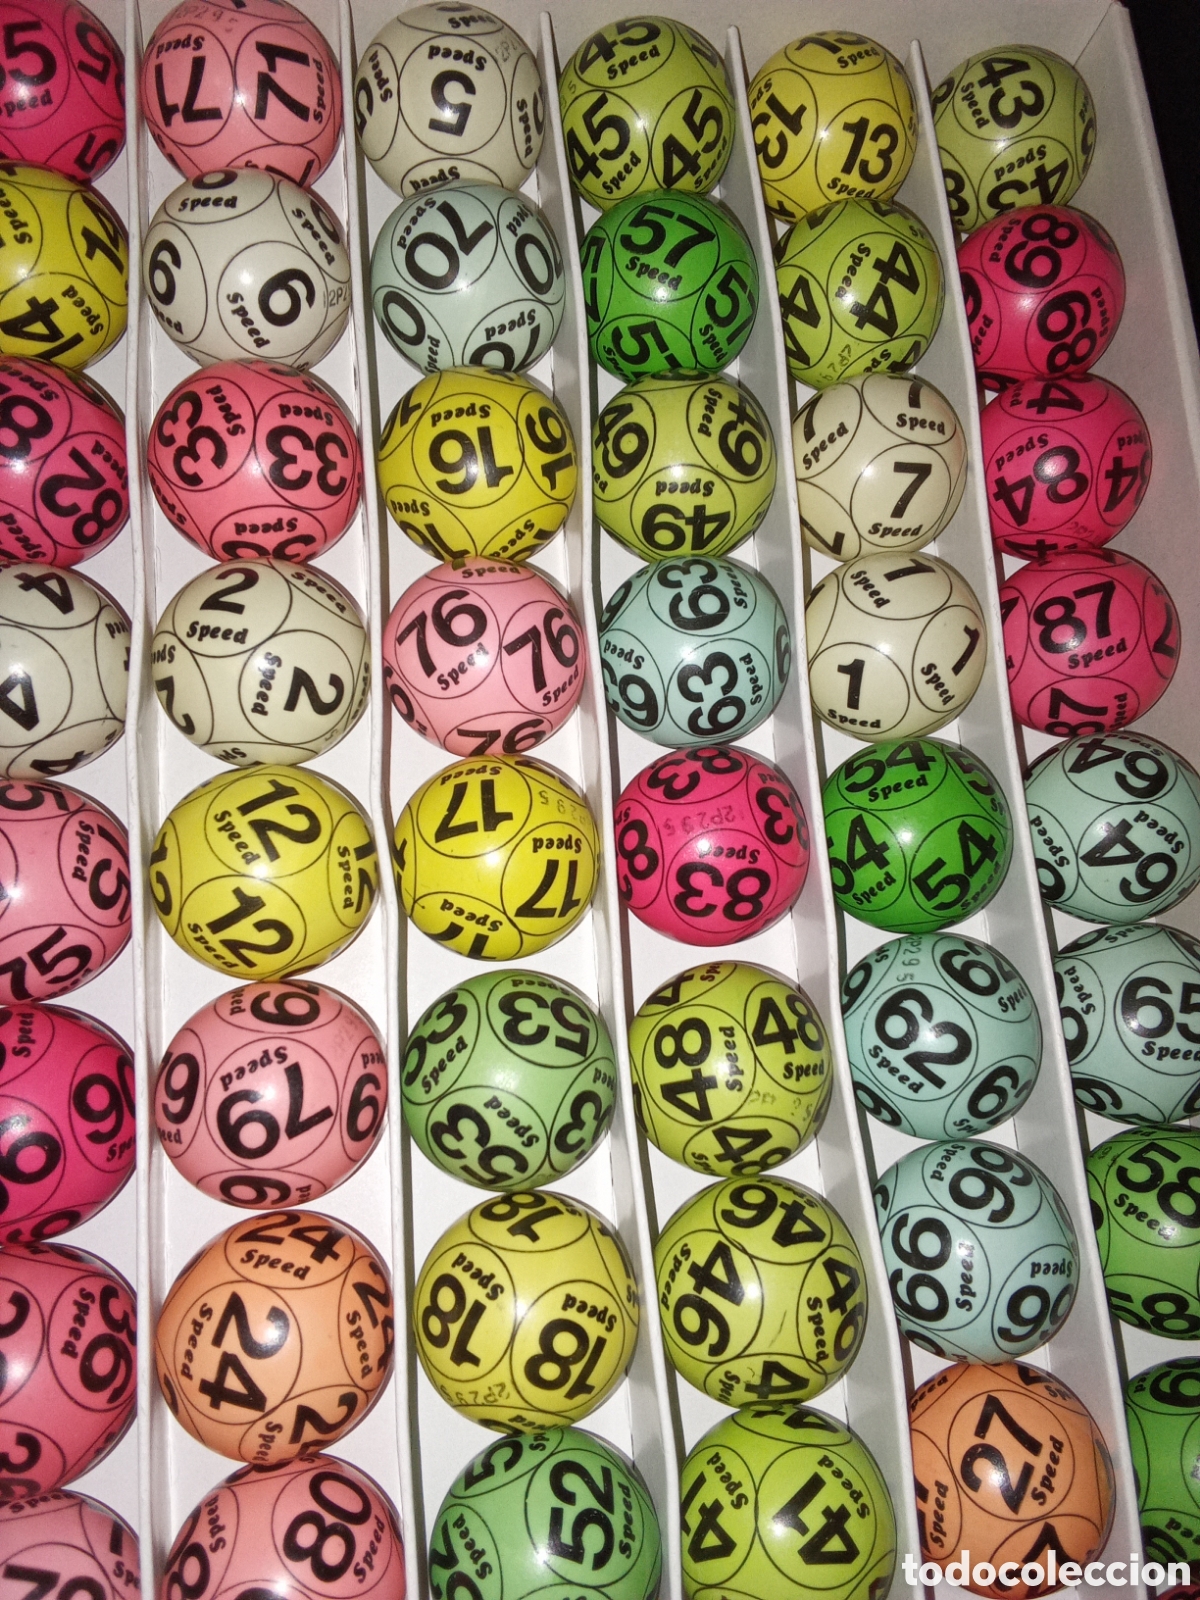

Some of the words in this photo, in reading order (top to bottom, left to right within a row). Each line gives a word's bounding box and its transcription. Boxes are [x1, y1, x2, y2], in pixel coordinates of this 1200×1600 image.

[156, 36, 205, 59] Speed
[428, 44, 487, 71] Speed
[578, 21, 661, 75] 45
[607, 44, 661, 80] Speed
[836, 47, 880, 69] Speed
[155, 56, 223, 127] 71
[255, 41, 310, 122] 71
[313, 58, 326, 124] Speed
[369, 51, 393, 103] Speed
[428, 69, 476, 137] 5
[978, 57, 1045, 129] 43
[516, 98, 534, 158] Speed
[960, 82, 990, 130] Speed
[566, 92, 631, 183] 45
[662, 88, 724, 189] 45
[694, 135, 729, 189] Speed
[841, 116, 898, 183] 13
[994, 144, 1047, 182] Speed
[602, 150, 642, 195] Speed
[827, 177, 876, 199] Speed
[179, 195, 238, 212] Speed
[396, 197, 437, 250] Speed
[292, 208, 336, 266] Speed
[404, 200, 494, 290] 70
[620, 205, 716, 269] 57
[989, 218, 1021, 263] Speed
[258, 268, 316, 327] 6
[625, 256, 683, 291] Speed
[850, 241, 920, 338] 44
[61, 285, 104, 336] Speed
[227, 292, 271, 348] Speed
[484, 308, 536, 341] Speed
[705, 265, 756, 346] 57
[699, 324, 728, 363] Speed
[206, 385, 245, 437] Speed
[278, 404, 333, 426] Speed
[431, 403, 490, 427] Speed
[698, 388, 722, 437] Speed
[896, 413, 945, 435] Speed
[157, 391, 228, 486] 33
[265, 425, 348, 496] 33
[429, 426, 514, 495] 16
[525, 406, 583, 491] 16
[802, 422, 849, 470] Speed
[995, 433, 1048, 471] Speed
[40, 447, 122, 545] 82
[391, 500, 430, 516] Speed
[655, 478, 714, 497] Speed
[890, 462, 932, 519] 7
[993, 445, 1089, 526] 84
[234, 518, 298, 535] Speed
[489, 519, 535, 557] Speed
[641, 503, 730, 551] 49
[868, 523, 923, 538] Speed
[14, 571, 74, 615] 4
[200, 567, 259, 615] 2
[291, 571, 347, 614] Speed
[462, 566, 520, 578] Speed
[657, 559, 730, 630] 63
[719, 565, 748, 609] Speed
[851, 571, 891, 608] Speed
[884, 559, 936, 582] 1
[187, 621, 248, 644] Speed
[396, 590, 488, 678] 76
[1033, 580, 1116, 654] 87
[437, 642, 489, 690] Speed
[503, 608, 579, 693] 76
[603, 640, 645, 669] Speed
[952, 625, 980, 677] 1
[1068, 638, 1128, 669] Speed
[252, 652, 282, 716] Speed
[284, 667, 345, 715] 2
[542, 664, 579, 706] Speed
[677, 652, 746, 736] 63
[739, 653, 763, 706] Speed
[837, 659, 865, 710] 1
[921, 663, 955, 706] Speed
[827, 709, 881, 729] Speed
[440, 765, 502, 785] Speed
[845, 741, 936, 792] 54
[868, 774, 929, 802] Speed
[1068, 738, 1169, 799] 64
[214, 810, 260, 865] Speed
[237, 779, 322, 862] 12
[434, 779, 513, 843] 17
[1133, 810, 1185, 854] Speed
[72, 821, 92, 882] Speed
[532, 834, 582, 853] Speed
[912, 820, 998, 911] 54
[1030, 815, 1070, 868] Speed
[1080, 818, 1178, 902] 64
[337, 846, 354, 909] Speed
[514, 859, 581, 918] 17
[674, 862, 771, 921] 83
[852, 871, 896, 905] Speed
[960, 862, 1001, 909] Speed
[206, 887, 294, 968] 12
[439, 898, 503, 932] Speed
[188, 922, 239, 969] Speed
[1064, 966, 1095, 1015] Speed
[13, 1012, 34, 1057] Speed
[498, 991, 590, 1057] 53
[752, 994, 824, 1054] 48
[875, 988, 972, 1090] 62
[220, 1046, 288, 1091] Speed
[421, 1035, 468, 1094] Speed
[654, 1017, 718, 1122] 48
[719, 1025, 744, 1092] Speed
[783, 1059, 824, 1081] Speed
[869, 1045, 924, 1094] Speed
[217, 1062, 334, 1159] 79
[483, 1096, 540, 1148] Speed
[430, 1103, 529, 1184] 53
[931, 1143, 966, 1181] Speed
[1116, 1142, 1200, 1228] 58
[235, 1211, 346, 1264] 24
[480, 1192, 564, 1243] 18
[721, 1184, 826, 1248] 46
[1114, 1194, 1175, 1241] Speed
[241, 1249, 311, 1281] Speed
[451, 1252, 504, 1301] Speed
[661, 1243, 691, 1311] Speed
[890, 1213, 952, 1322] 66
[1030, 1259, 1073, 1278] Speed
[61, 1288, 95, 1359] Speed
[422, 1273, 487, 1368] 18
[561, 1293, 617, 1333] Speed
[673, 1240, 745, 1357] 46
[181, 1303, 213, 1381] Speed
[199, 1291, 290, 1412] 24
[347, 1310, 373, 1379] Speed
[807, 1297, 830, 1363] Speed
[524, 1318, 607, 1400] 18
[252, 1421, 283, 1463] Speed
[961, 1394, 1042, 1515] 27
[706, 1452, 749, 1510] Speed
[817, 1455, 870, 1519] Speed
[1031, 1435, 1064, 1506] Speed
[283, 1472, 372, 1582] 80
[549, 1460, 614, 1571] 52
[619, 1482, 635, 1559] Speed
[772, 1472, 860, 1565] 41
[930, 1480, 948, 1548] Speed
[353, 1516, 384, 1584] Speed
[453, 1513, 492, 1580] Speed
